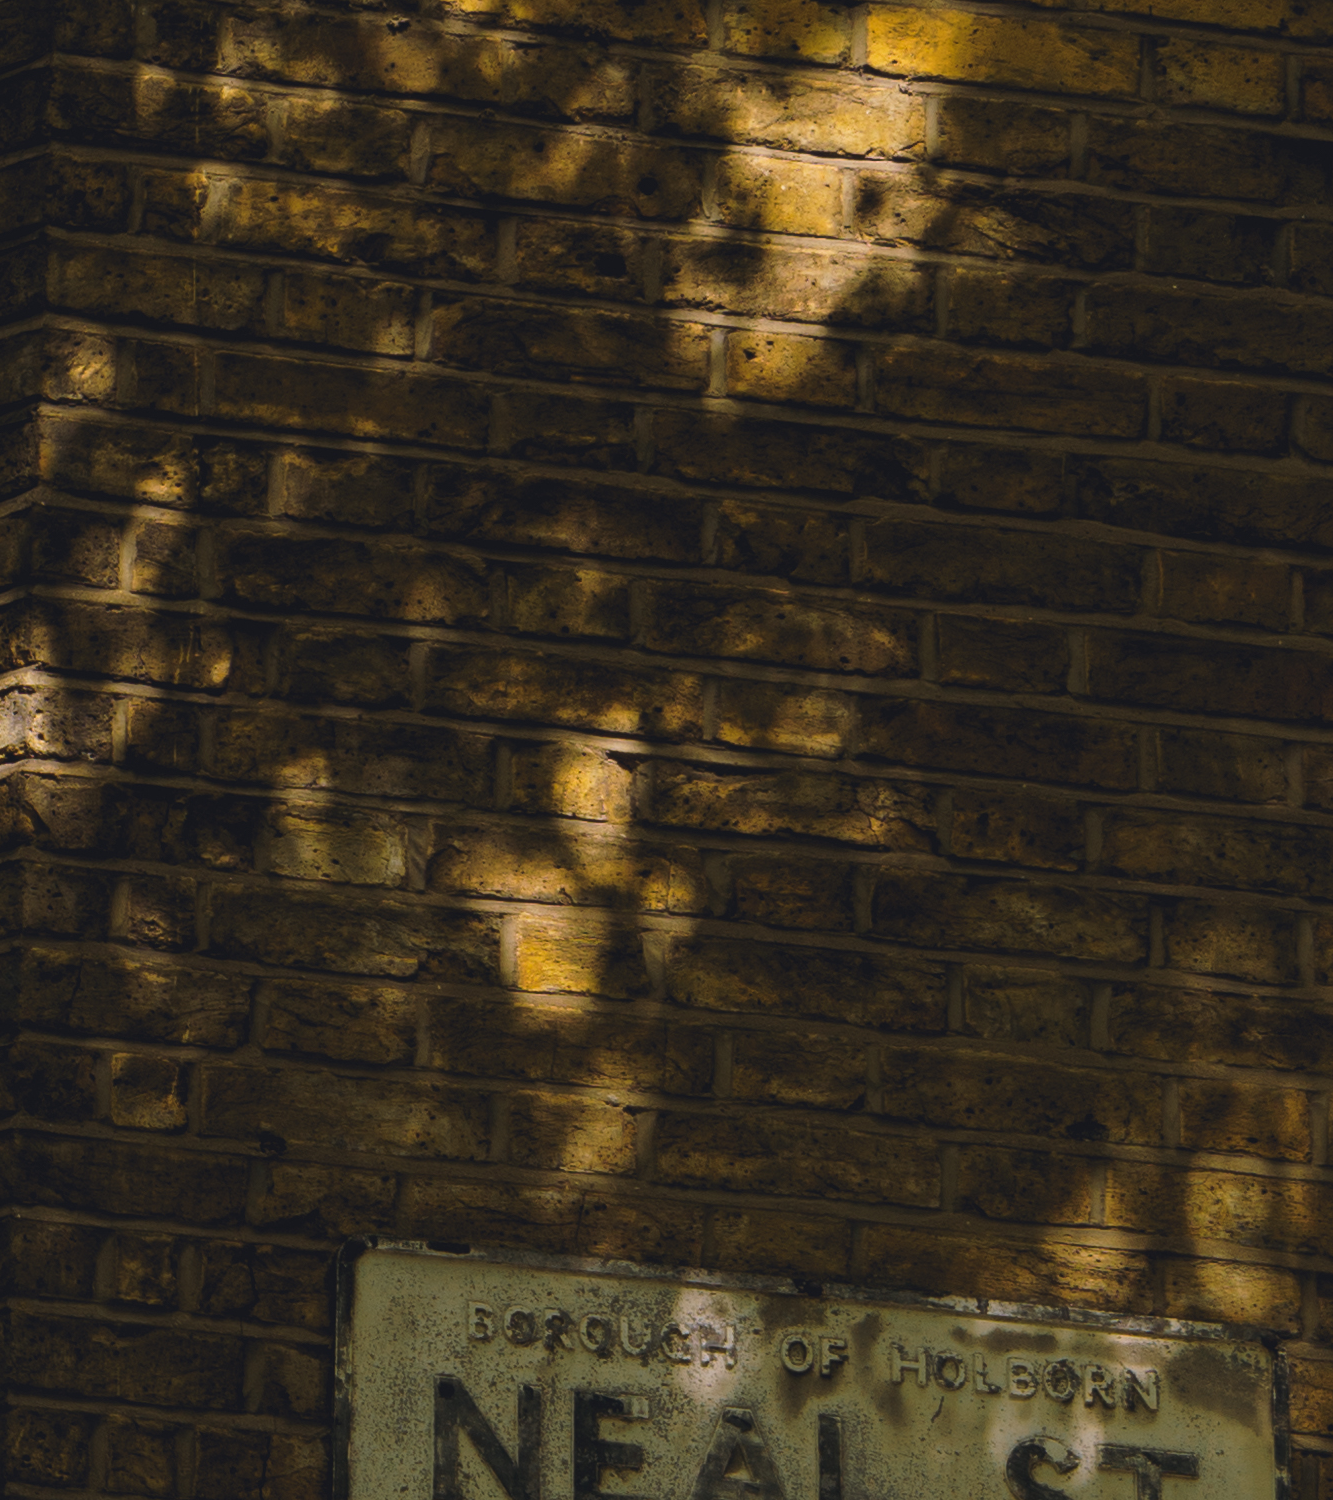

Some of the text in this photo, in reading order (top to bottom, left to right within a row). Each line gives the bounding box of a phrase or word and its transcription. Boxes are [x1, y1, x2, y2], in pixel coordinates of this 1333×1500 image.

[466, 1299, 1162, 1412] BOROUGH OF HOLBORN
